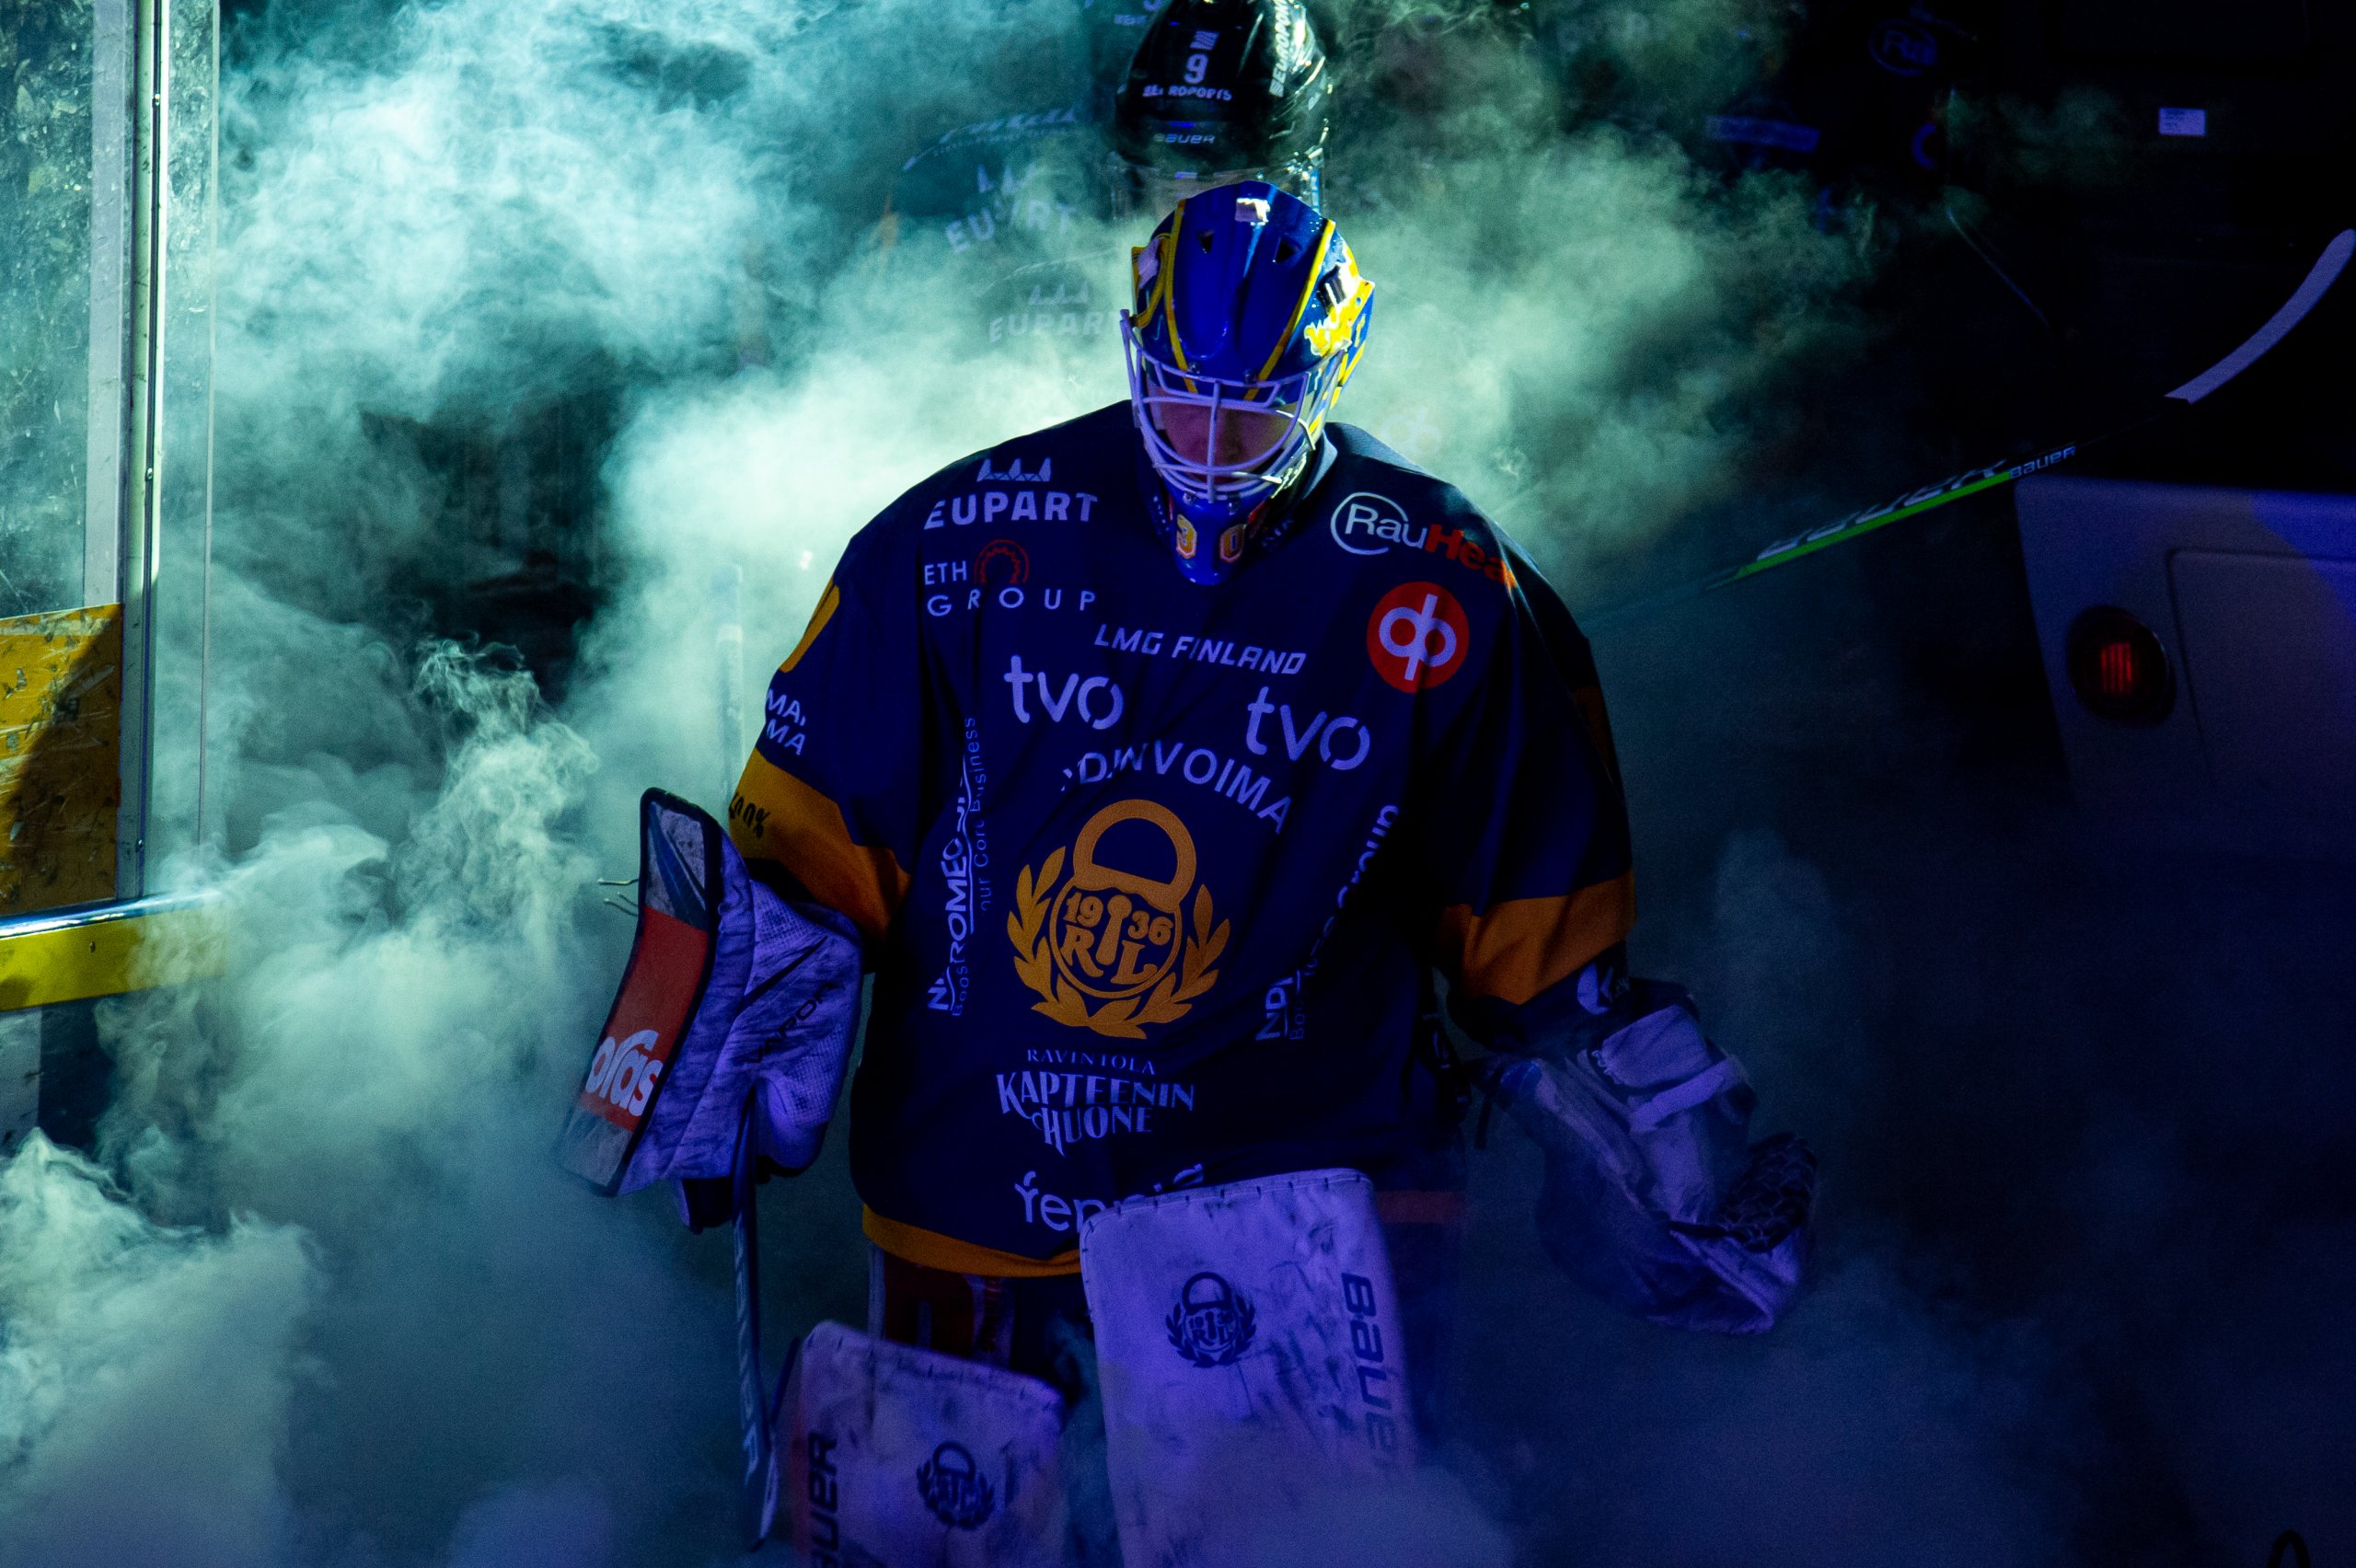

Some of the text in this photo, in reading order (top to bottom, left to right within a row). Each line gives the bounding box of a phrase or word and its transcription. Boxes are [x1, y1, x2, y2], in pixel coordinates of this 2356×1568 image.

[1184, 52, 1209, 85] 9
[923, 490, 1099, 530] EUPART
[923, 559, 967, 586] ETH
[927, 587, 1096, 617] GROUP
[1093, 624, 1307, 675] LMG FINLAND
[1002, 653, 1125, 731] tvo
[1246, 686, 1372, 771] tvo
[996, 1070, 1195, 1120] KAPTEENIN
[1032, 1105, 1154, 1158] HUONE
